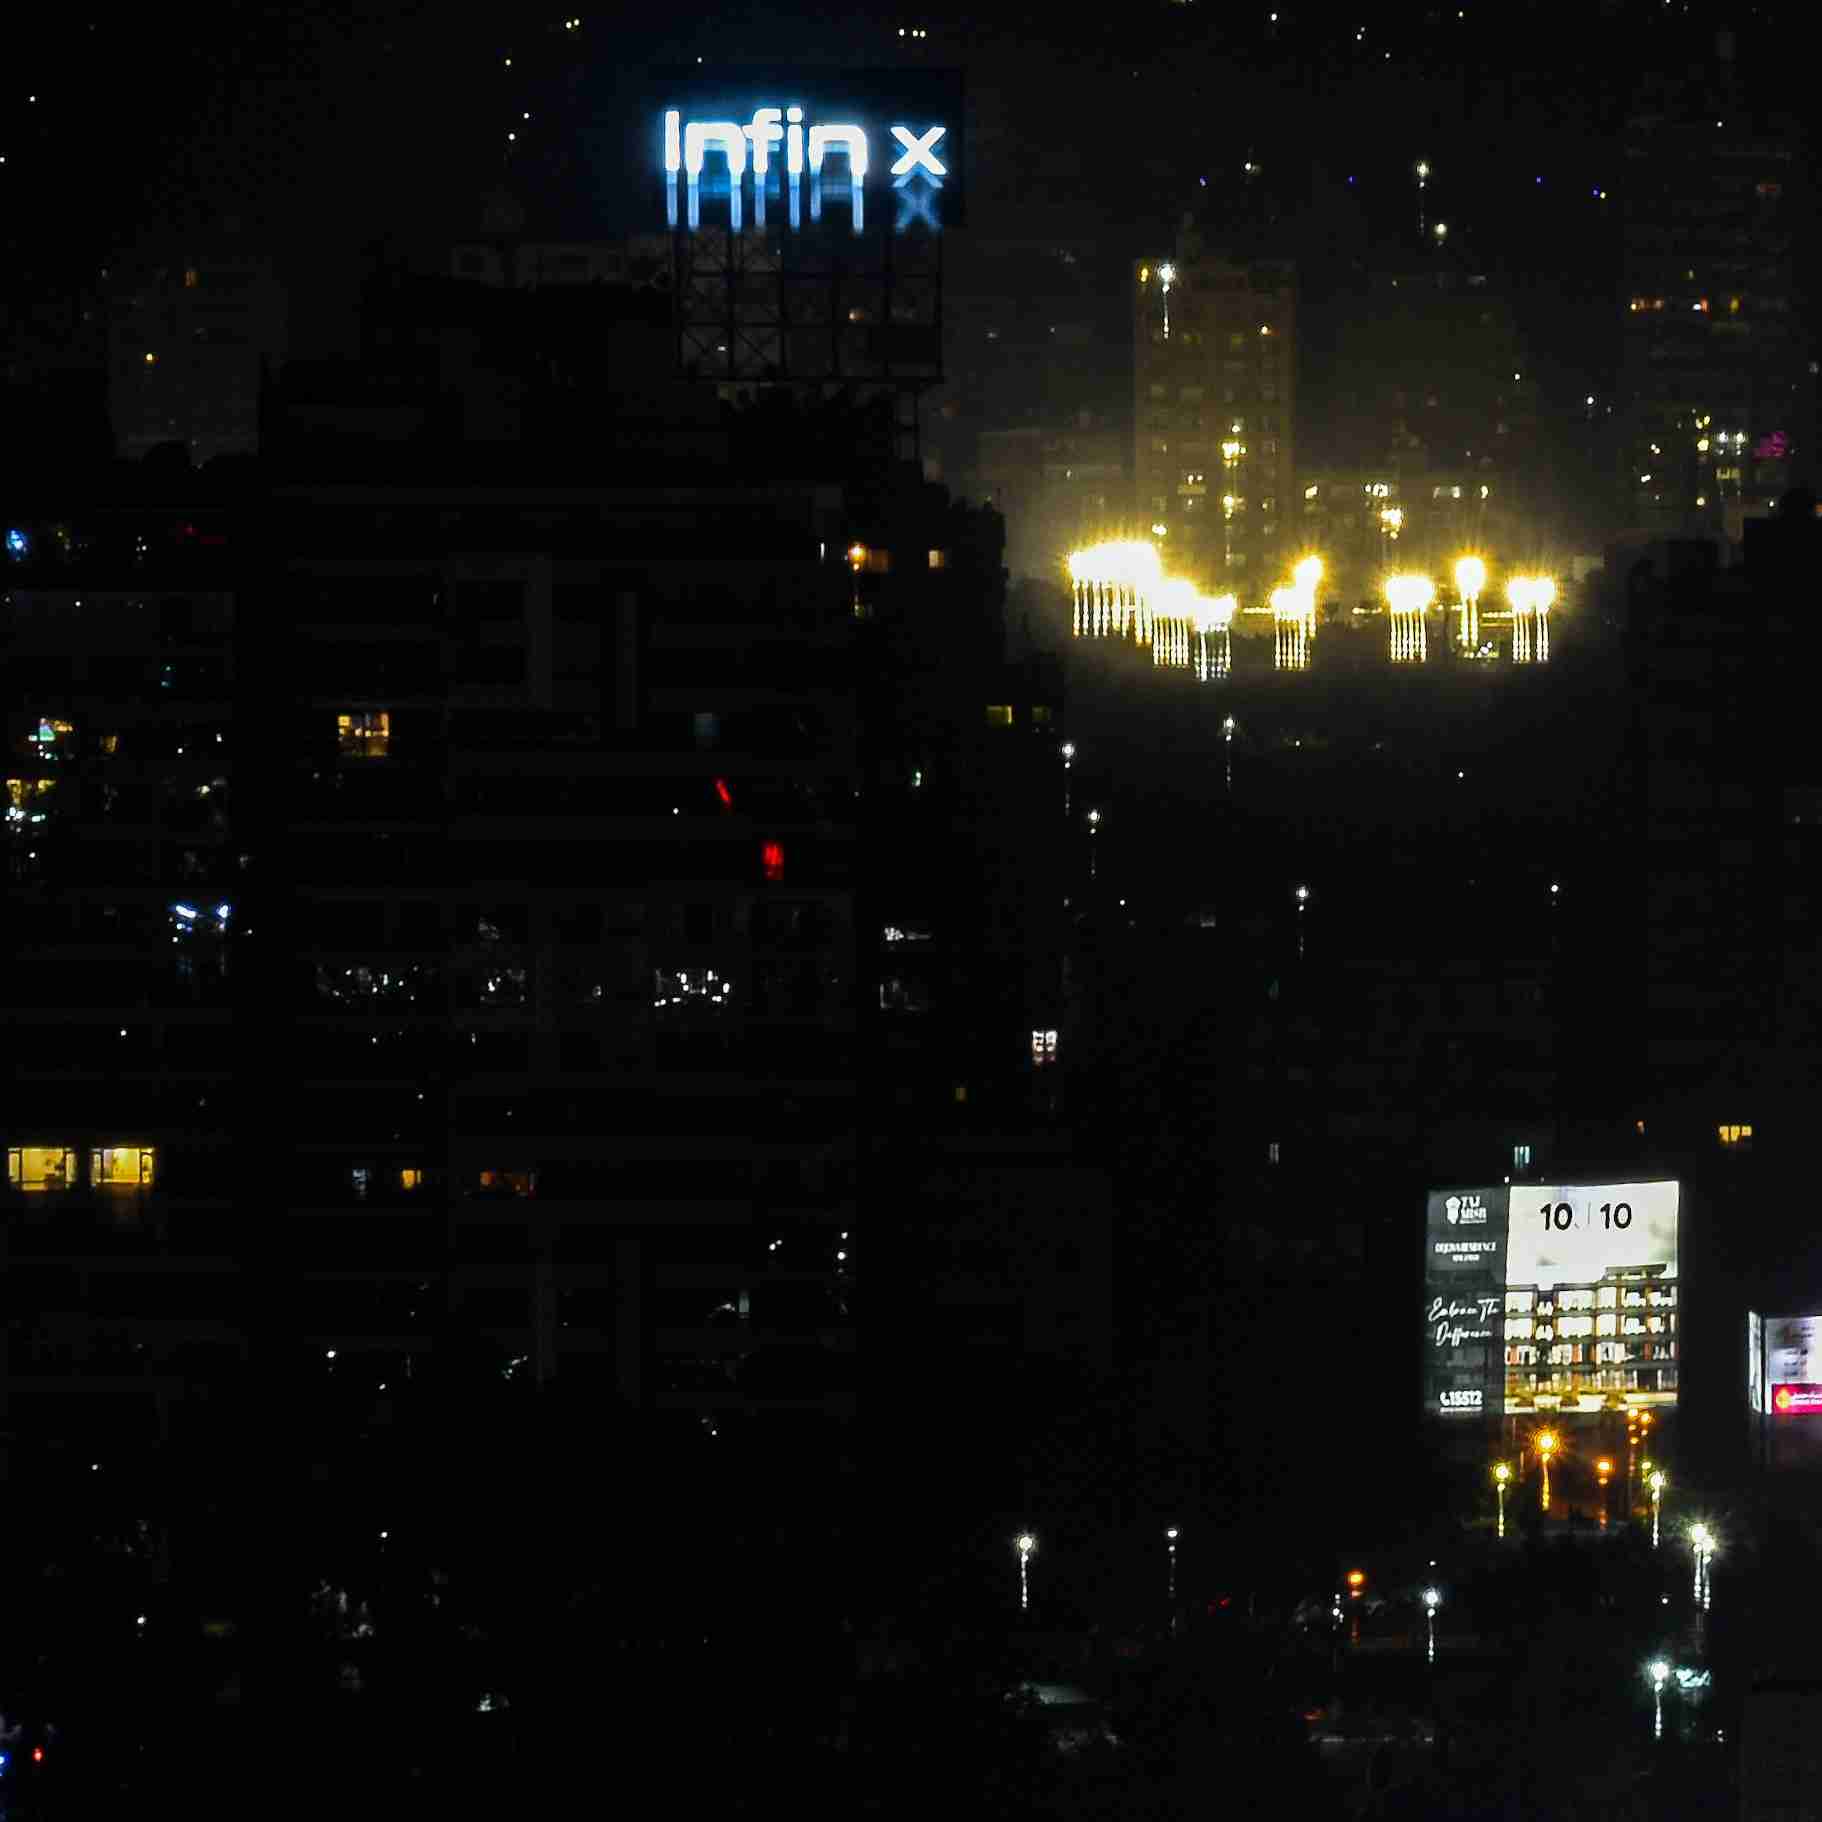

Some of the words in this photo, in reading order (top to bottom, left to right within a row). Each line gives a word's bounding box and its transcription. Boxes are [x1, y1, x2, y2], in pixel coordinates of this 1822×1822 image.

[1540, 1202, 1573, 1231] 10
[1599, 1202, 1633, 1231] 10
[1477, 1298, 1501, 1323] The
